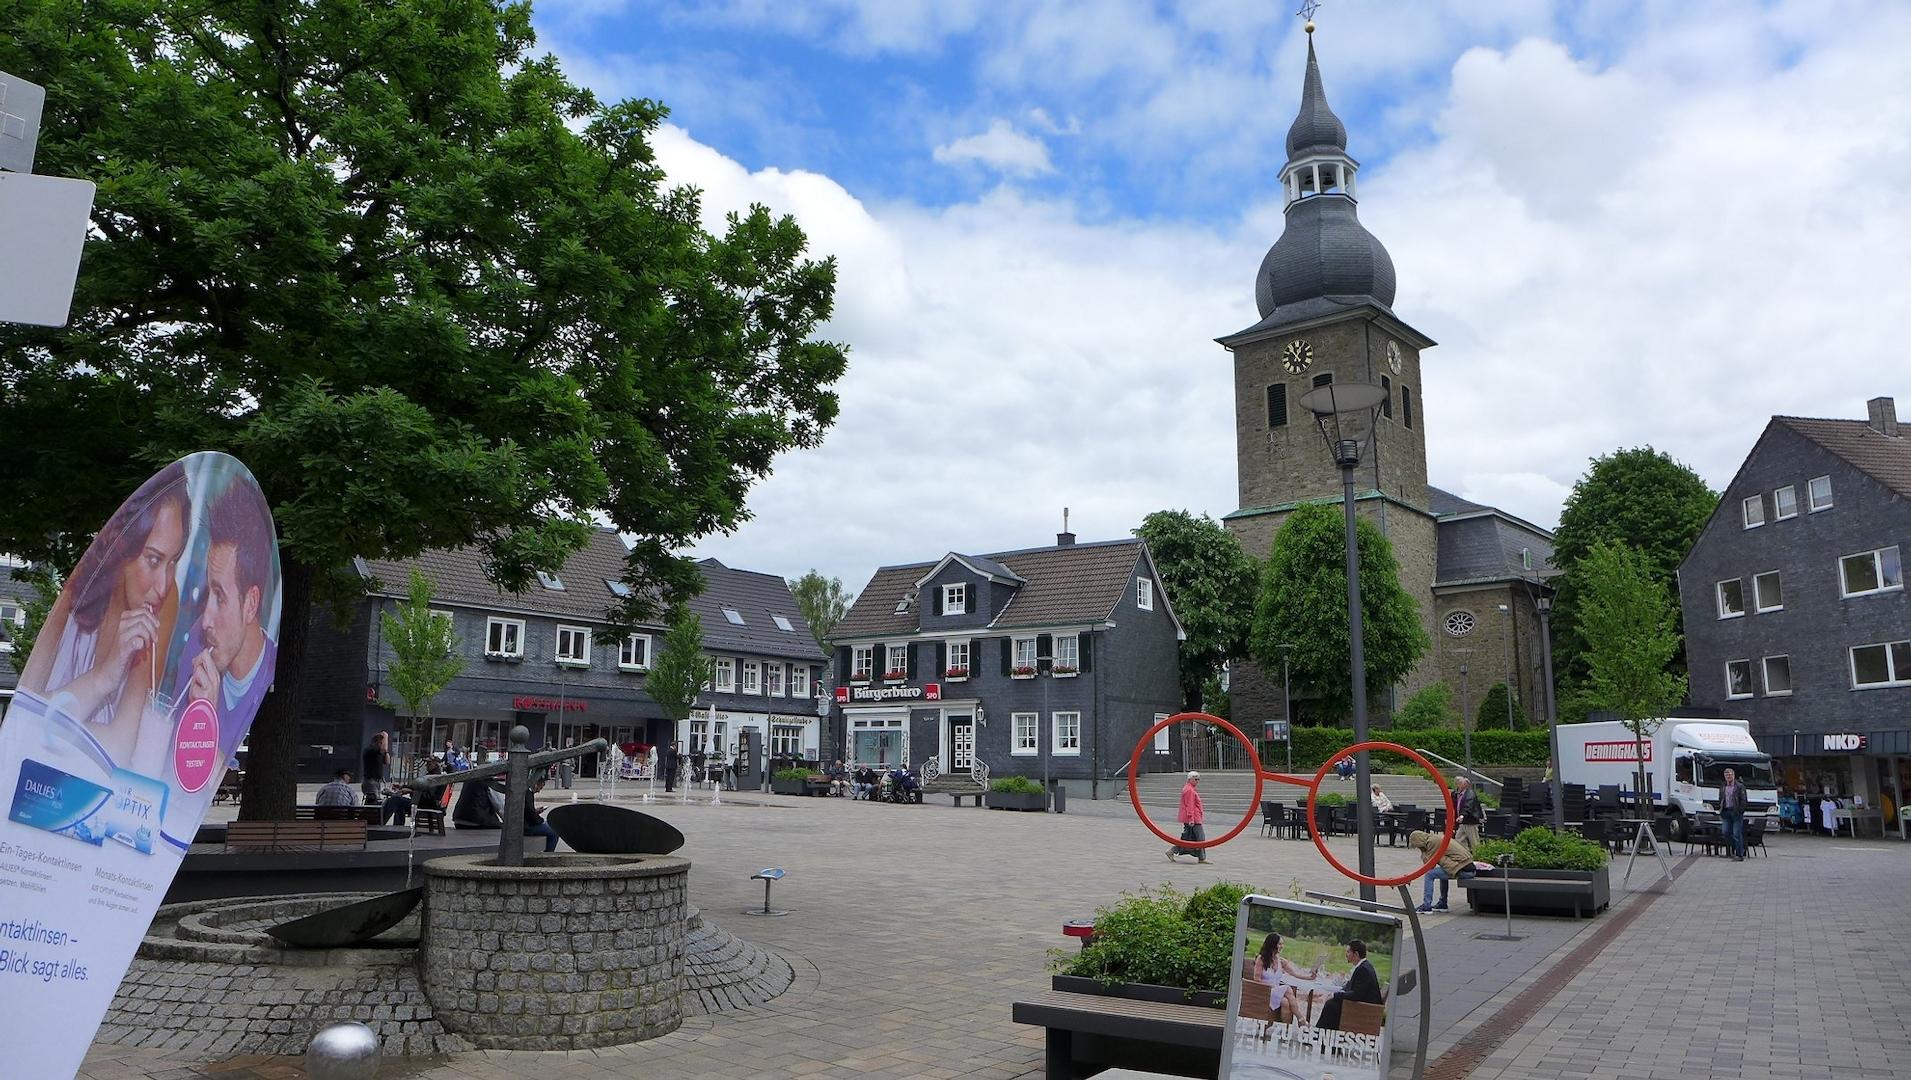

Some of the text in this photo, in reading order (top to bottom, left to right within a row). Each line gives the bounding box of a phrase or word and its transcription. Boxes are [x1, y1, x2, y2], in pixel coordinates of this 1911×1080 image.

[853, 685, 921, 701] Bürgerbüro
[24, 779, 56, 799] DAILIES
[0, 918, 68, 946] ntaktlinsen
[0, 950, 89, 983] Blick sagt alles.
